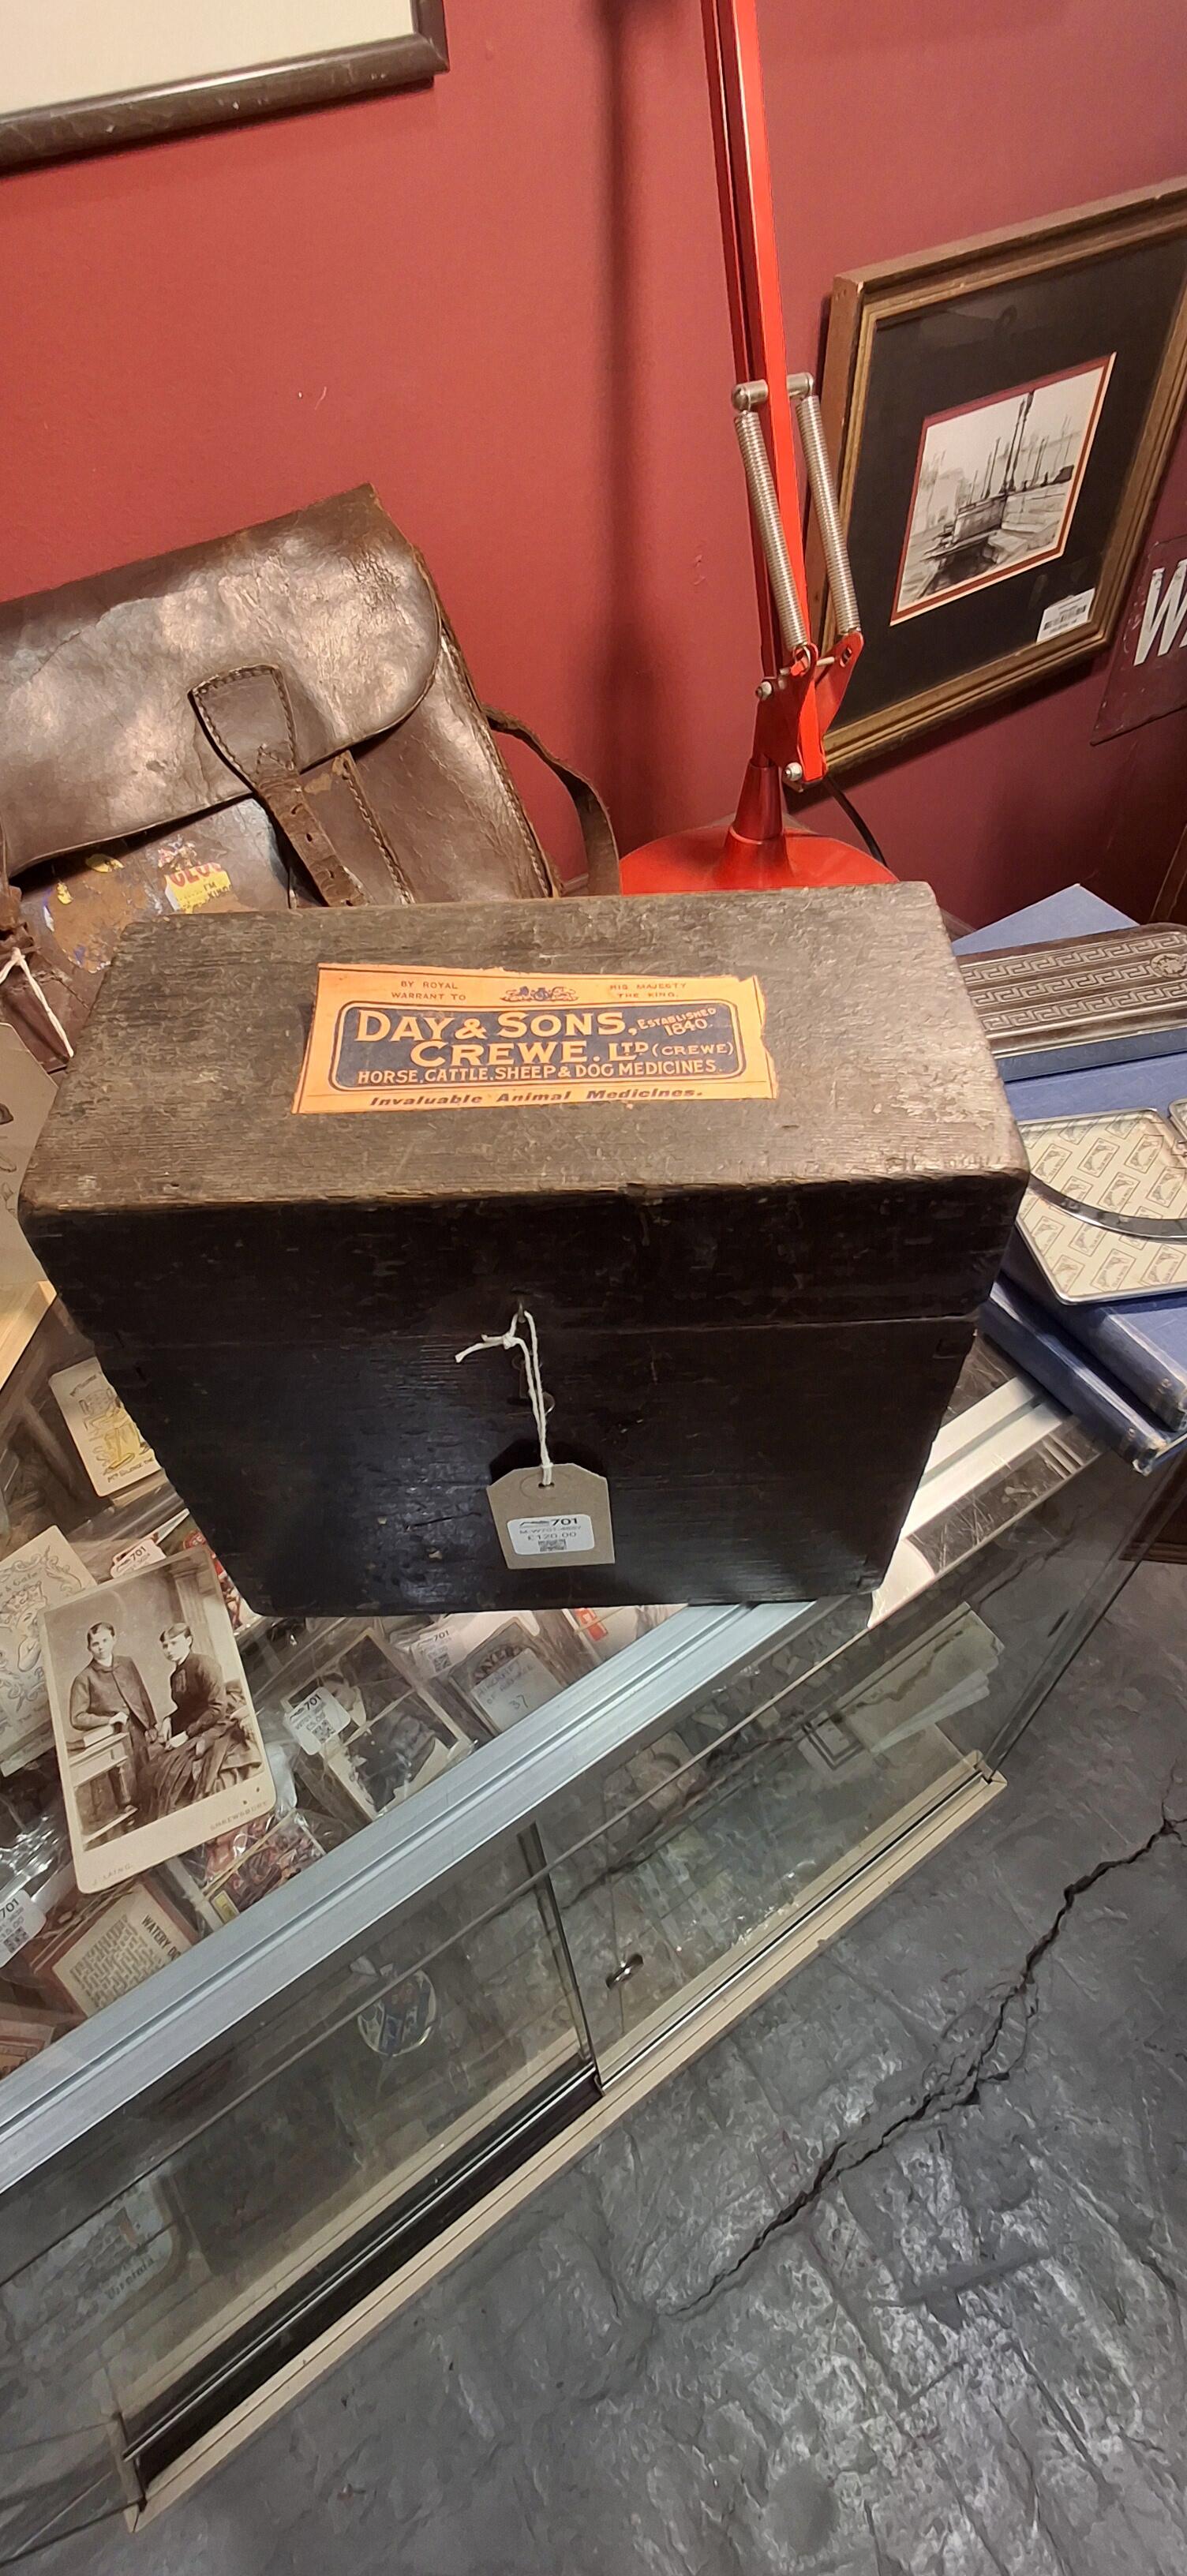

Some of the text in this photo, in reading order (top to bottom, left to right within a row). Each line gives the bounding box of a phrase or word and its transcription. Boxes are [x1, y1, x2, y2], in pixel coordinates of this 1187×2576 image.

[422, 980, 459, 990] ROYAL
[391, 991, 466, 1002] WARRANT TO
[354, 1009, 455, 1042] DAY
[454, 1018, 489, 1040] &
[651, 1041, 735, 1058] (CREWE)
[557, 1066, 571, 1079] &
[575, 1063, 615, 1078] DOG
[369, 1088, 703, 1106] Invaluable Animal Medicines.
[550, 1518, 578, 1526] 701
[129, 1546, 147, 1561] 701
[433, 1630, 450, 1642] 701
[304, 1694, 321, 1711] 701
[509, 1694, 529, 1709] 37
[0, 1897, 20, 1919] 701
[140, 1914, 172, 1949] WATERY
